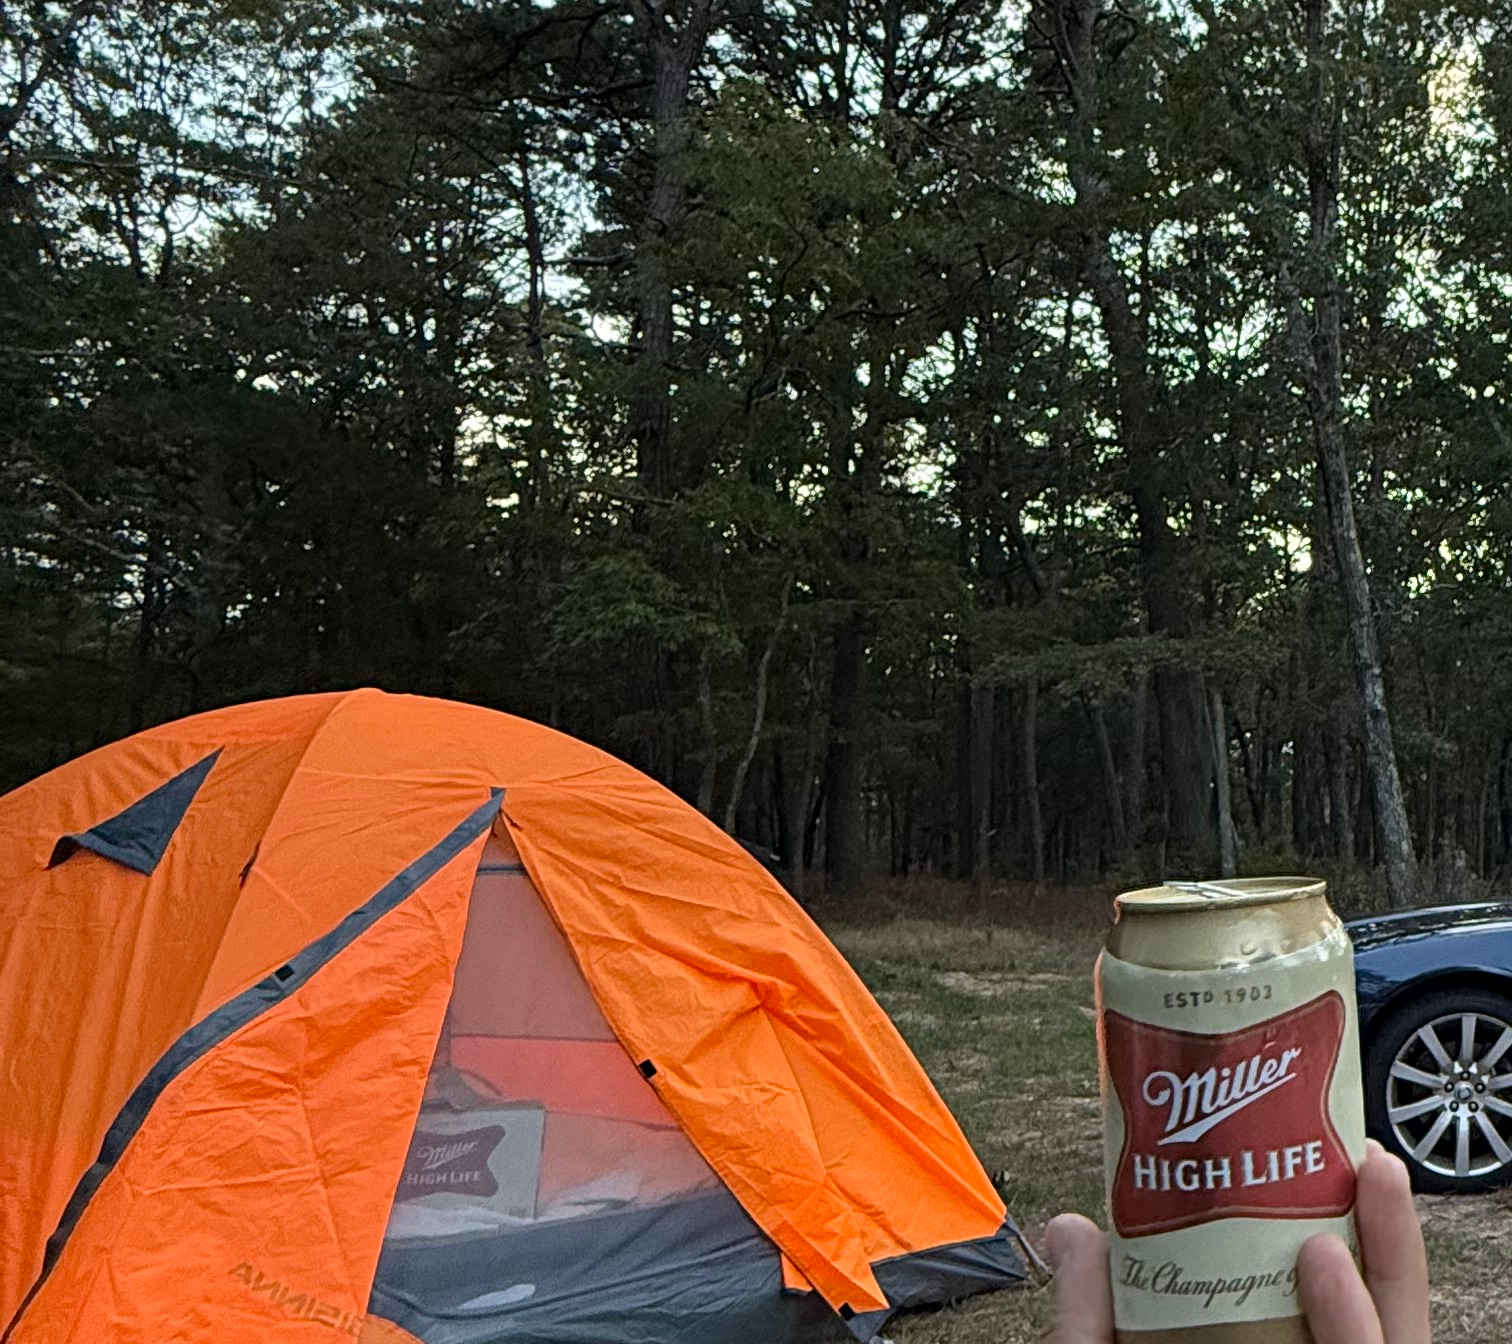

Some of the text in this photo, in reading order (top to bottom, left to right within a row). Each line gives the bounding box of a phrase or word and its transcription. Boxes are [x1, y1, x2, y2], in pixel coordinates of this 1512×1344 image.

[1163, 984, 1273, 1009] ESTD 1903
[1143, 1047, 1302, 1134] Miller
[1134, 1140, 1326, 1191] HIGH LIFE
[1120, 1256, 1150, 1290] The
[1151, 1261, 1281, 1308] Champagne
